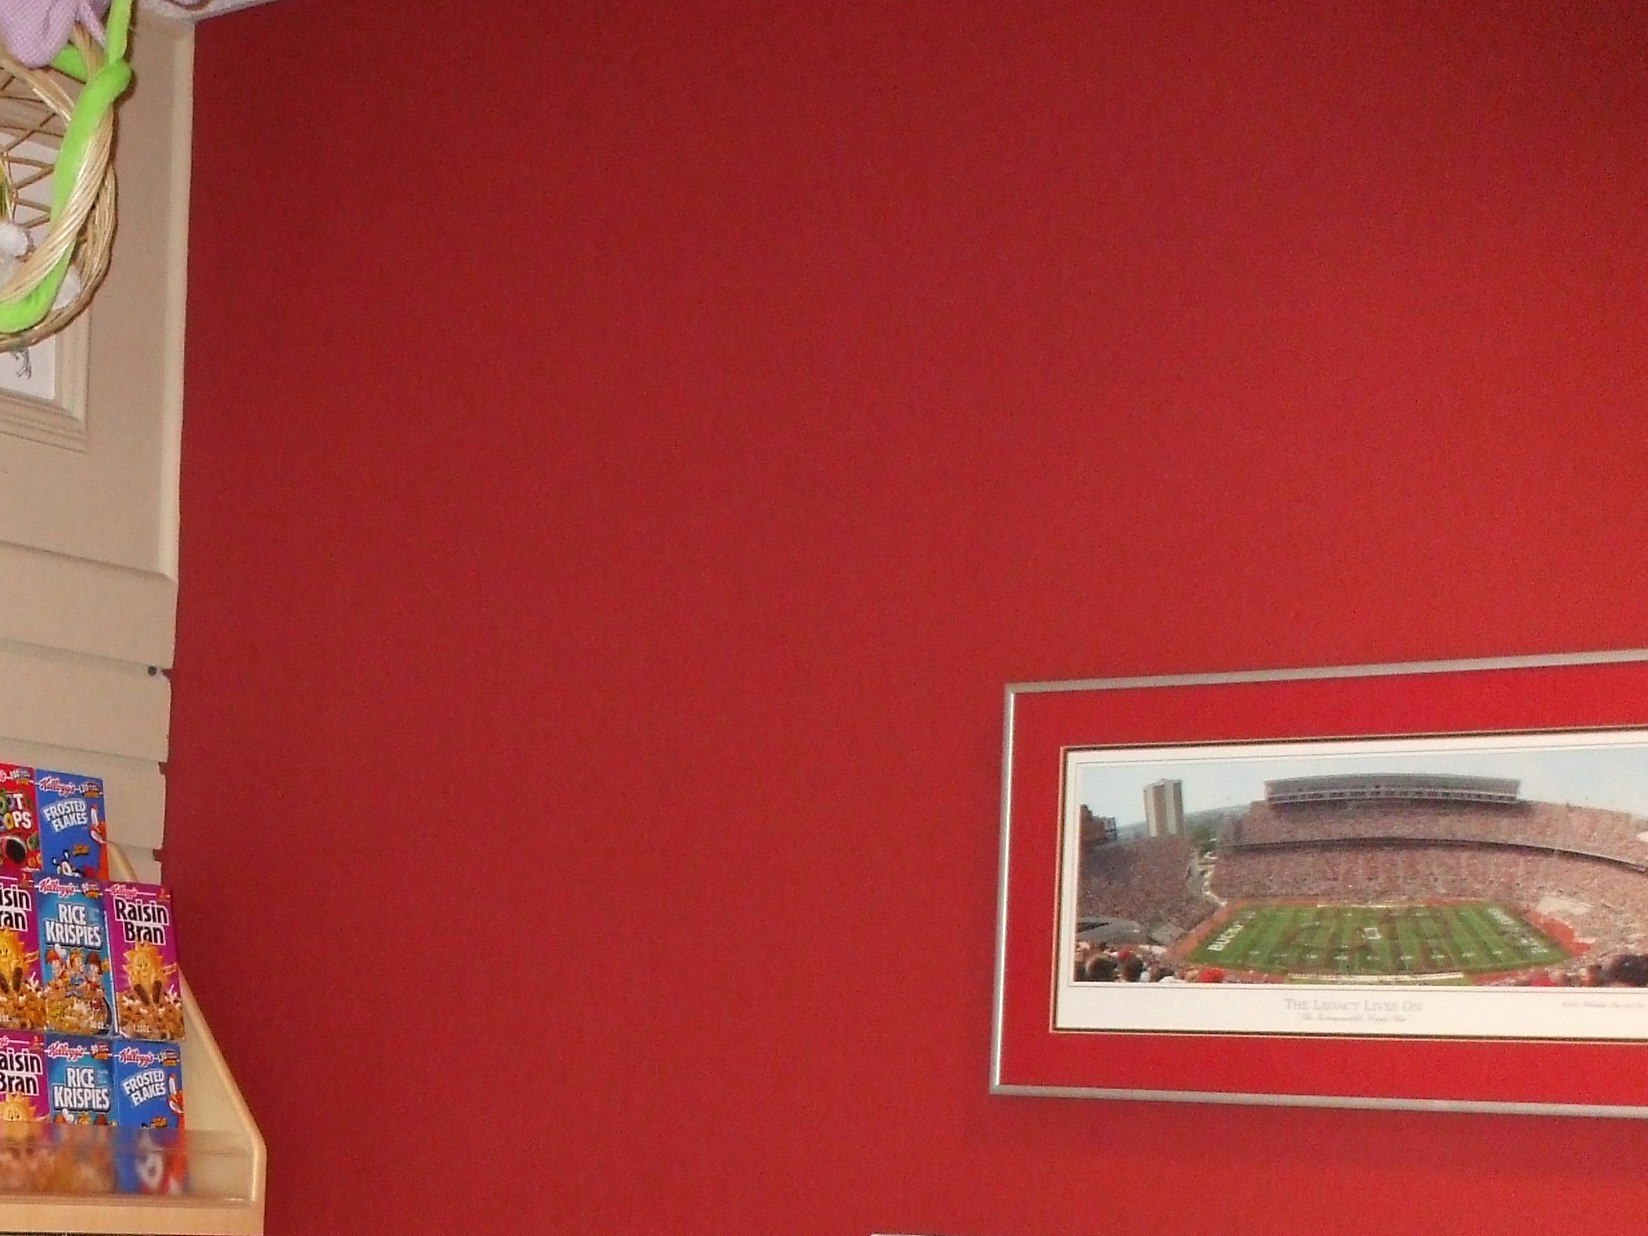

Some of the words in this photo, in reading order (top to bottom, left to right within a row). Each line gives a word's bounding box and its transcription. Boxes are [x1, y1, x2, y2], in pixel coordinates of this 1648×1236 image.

[43, 800, 87, 822] FROSTED
[52, 813, 88, 834] FLAKES
[58, 903, 87, 925] RICE
[46, 921, 102, 947] KRISPIES
